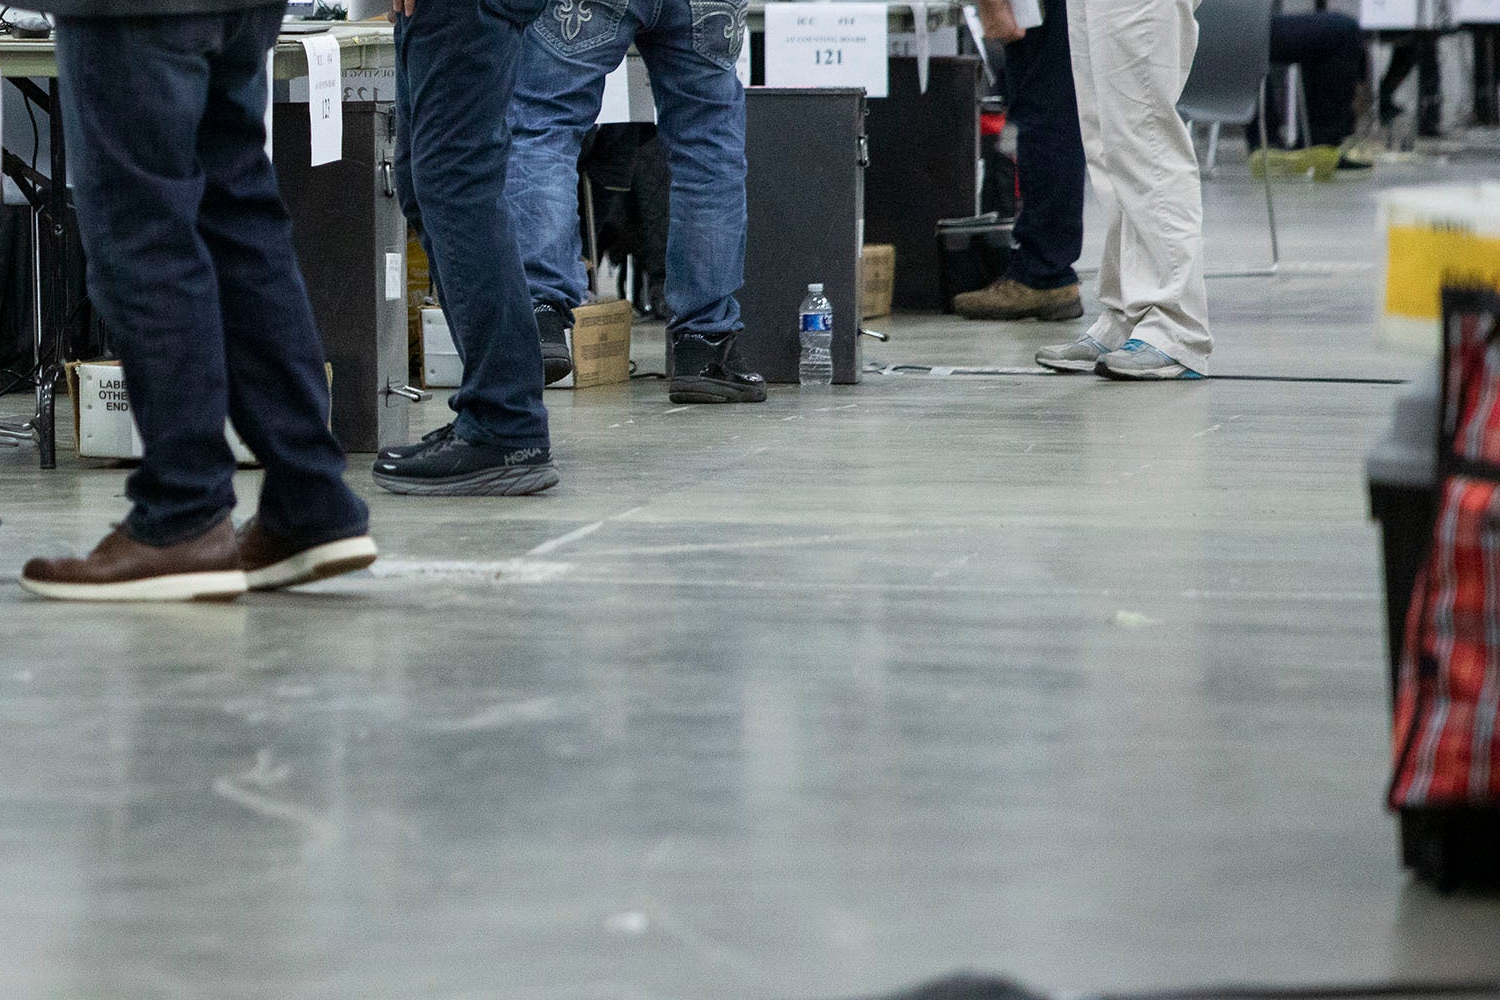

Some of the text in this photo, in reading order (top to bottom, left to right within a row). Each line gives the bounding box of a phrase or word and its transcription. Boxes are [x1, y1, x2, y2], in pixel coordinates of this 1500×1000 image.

[815, 49, 843, 65] 121
[99, 380, 128, 389] LABE
[98, 391, 129, 400] OTHE
[106, 402, 129, 411] END
